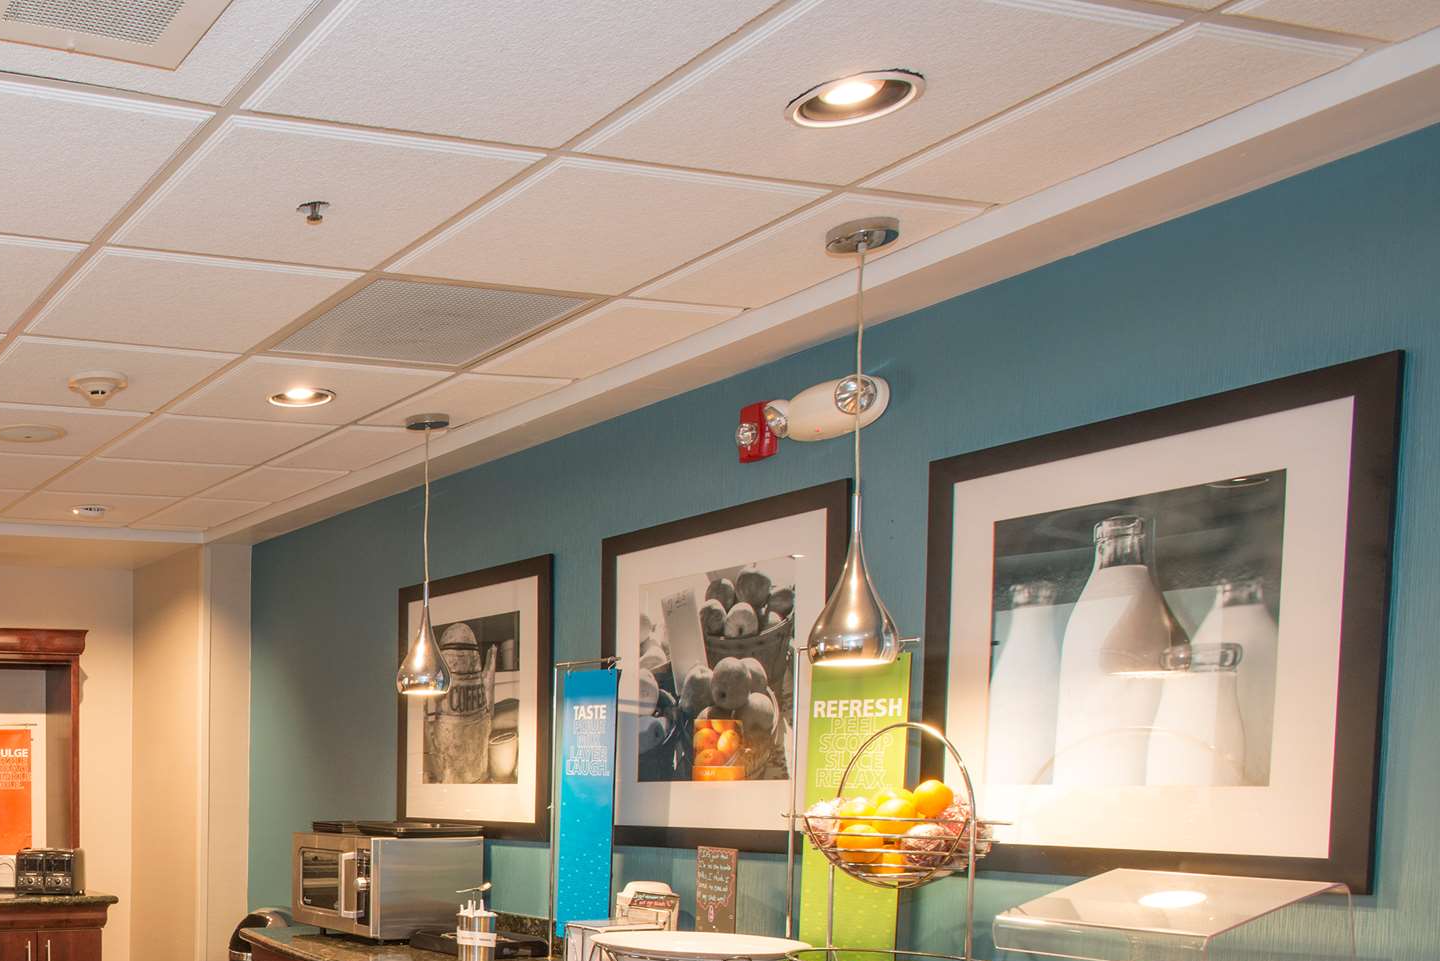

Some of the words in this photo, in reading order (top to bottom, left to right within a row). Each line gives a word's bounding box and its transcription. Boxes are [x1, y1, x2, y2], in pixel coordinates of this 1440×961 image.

[573, 704, 607, 720] TASTE
[813, 697, 903, 718] REFRESH
[831, 717, 877, 735] PEEL
